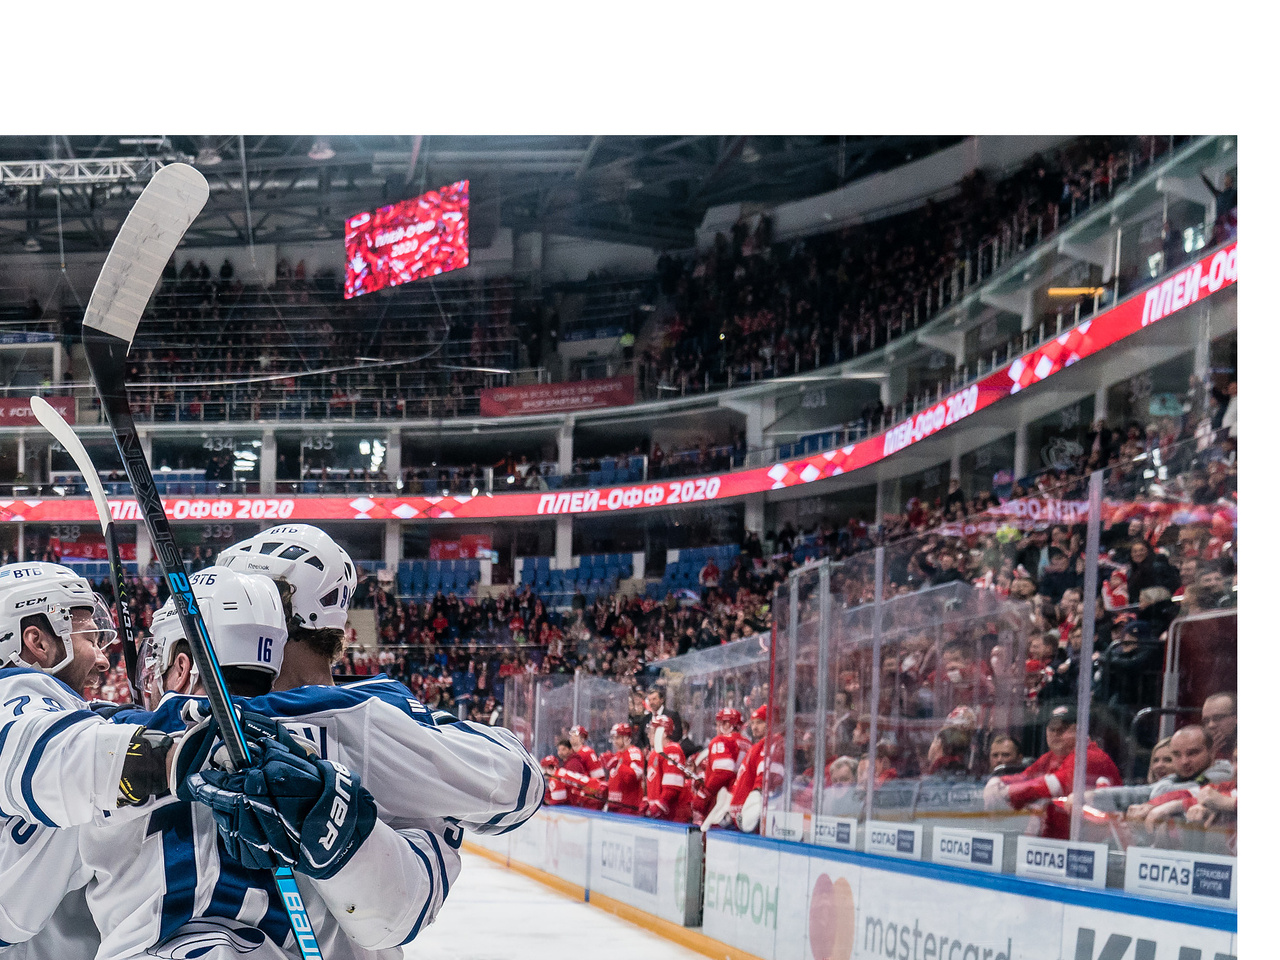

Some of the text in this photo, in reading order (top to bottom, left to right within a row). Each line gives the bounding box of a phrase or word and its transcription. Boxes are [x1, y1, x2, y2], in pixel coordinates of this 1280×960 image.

[10, 407, 67, 417] #СПАК
[884, 384, 979, 456] ПЛЕЙ-ОФФ 2020
[203, 437, 233, 451] 434
[301, 436, 333, 450] 435
[115, 428, 182, 568] NEXUS
[537, 476, 721, 514] ПЛЕЙ-ОФФ 2020
[108, 500, 295, 519] ПЛ-ОФФ 2020
[51, 525, 80, 539] 338
[203, 525, 233, 539] 339
[270, 526, 298, 535] ВТБ
[13, 568, 43, 579] ВТБ
[248, 563, 270, 571] Reebok
[15, 596, 48, 609] CCM
[175, 593, 189, 616] PRO
[120, 600, 134, 642] CCM
[257, 636, 273, 663] 16
[871, 831, 895, 846] СОГАЗ
[940, 838, 970, 856] СОГАЗ
[1026, 850, 1065, 869] СОГАЗ
[1138, 863, 1190, 886] СОГАЗ
[706, 868, 778, 930] ЕГАФОН
